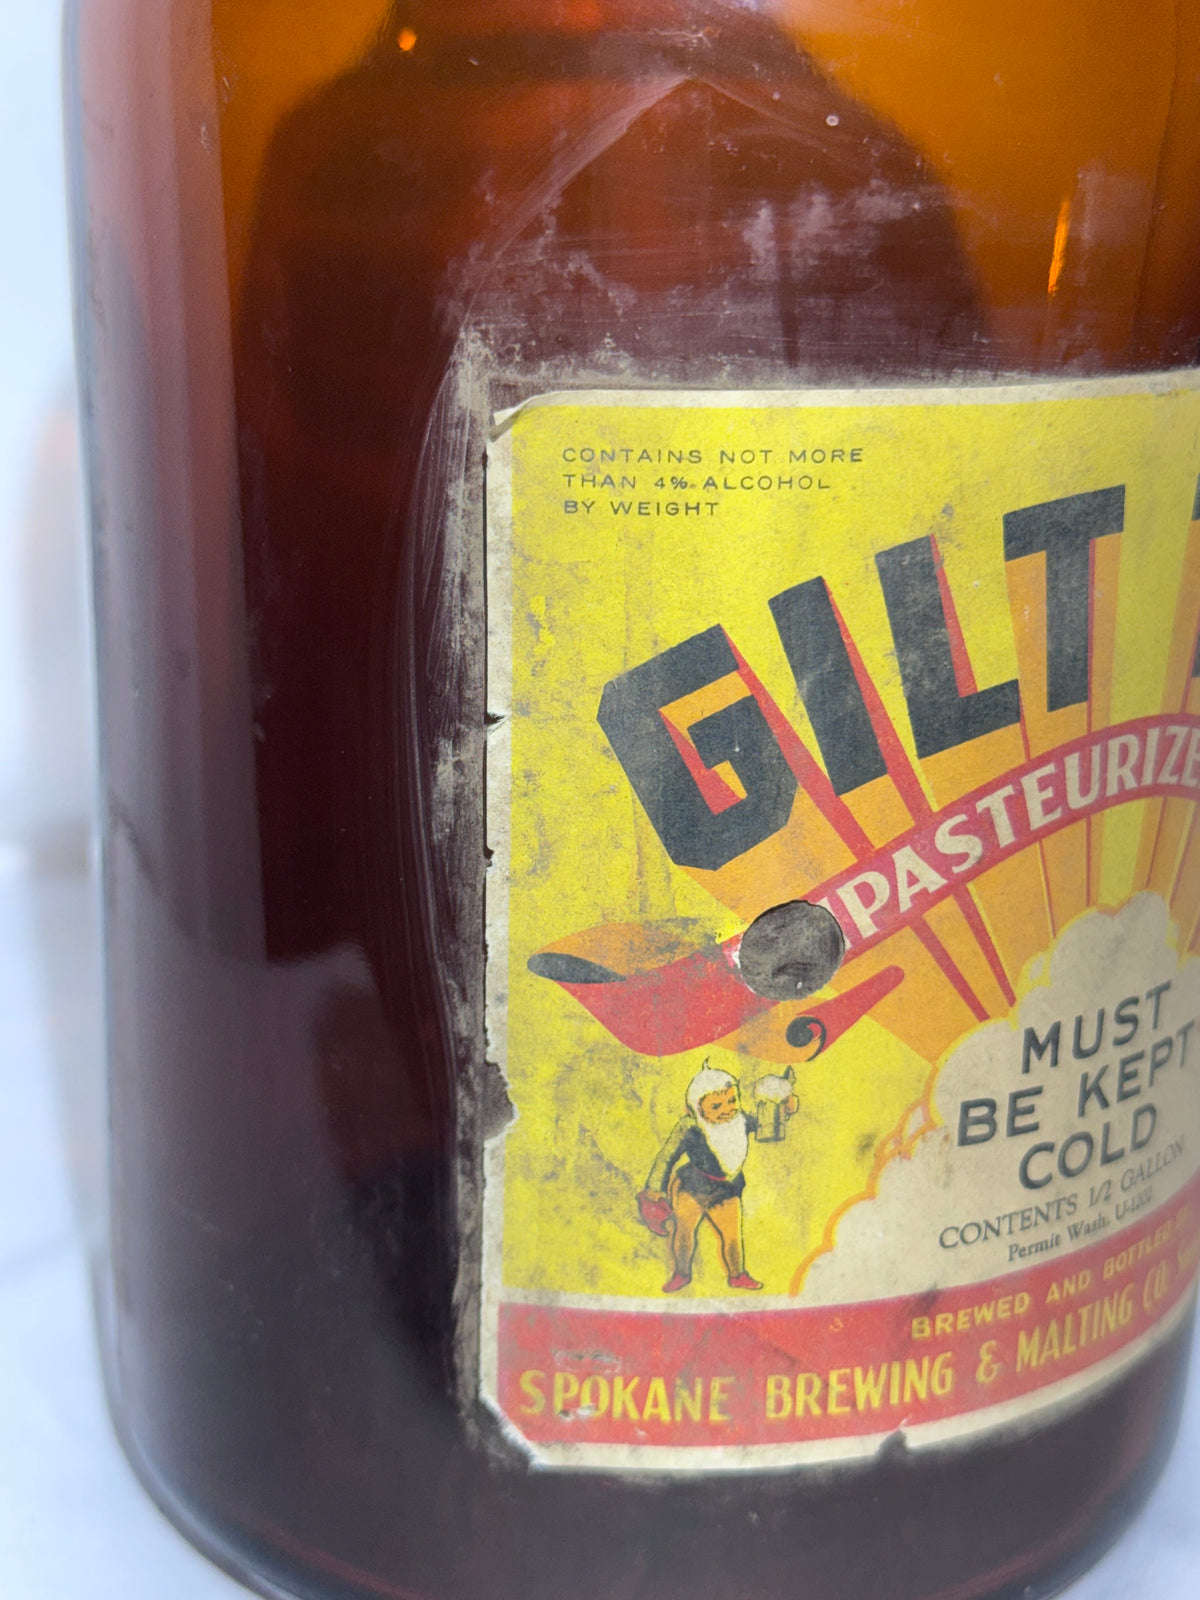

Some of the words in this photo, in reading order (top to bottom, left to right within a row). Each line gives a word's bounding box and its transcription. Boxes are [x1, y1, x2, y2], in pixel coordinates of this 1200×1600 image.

[562, 448, 702, 463] CONTAINS
[720, 450, 772, 463] NOT
[789, 448, 863, 463] MORE
[563, 474, 636, 489] THAN
[703, 475, 830, 490] ALCOHOL
[564, 501, 595, 514] BY
[610, 501, 719, 516] WEIGHT
[596, 484, 1125, 871] GILT
[1022, 979, 1171, 1074] MUST
[957, 1085, 1043, 1147] BE
[1078, 1019, 1195, 1118] KEPT
[938, 1193, 1078, 1249] CONTENTS
[1088, 1179, 1112, 1207] 1/2
[1120, 1134, 1185, 1192] GALLON
[1018, 1102, 1157, 1190] COLD
[911, 1291, 1031, 1340] BREWED
[1045, 1268, 1093, 1304] AND
[1103, 1220, 1174, 1280] BOTTLED
[1007, 1232, 1060, 1262] Permit
[518, 1369, 736, 1423] SPOKANE
[765, 1351, 954, 1420] BREWING
[976, 1339, 1003, 1383] &
[1015, 1283, 1135, 1373] MALTING
